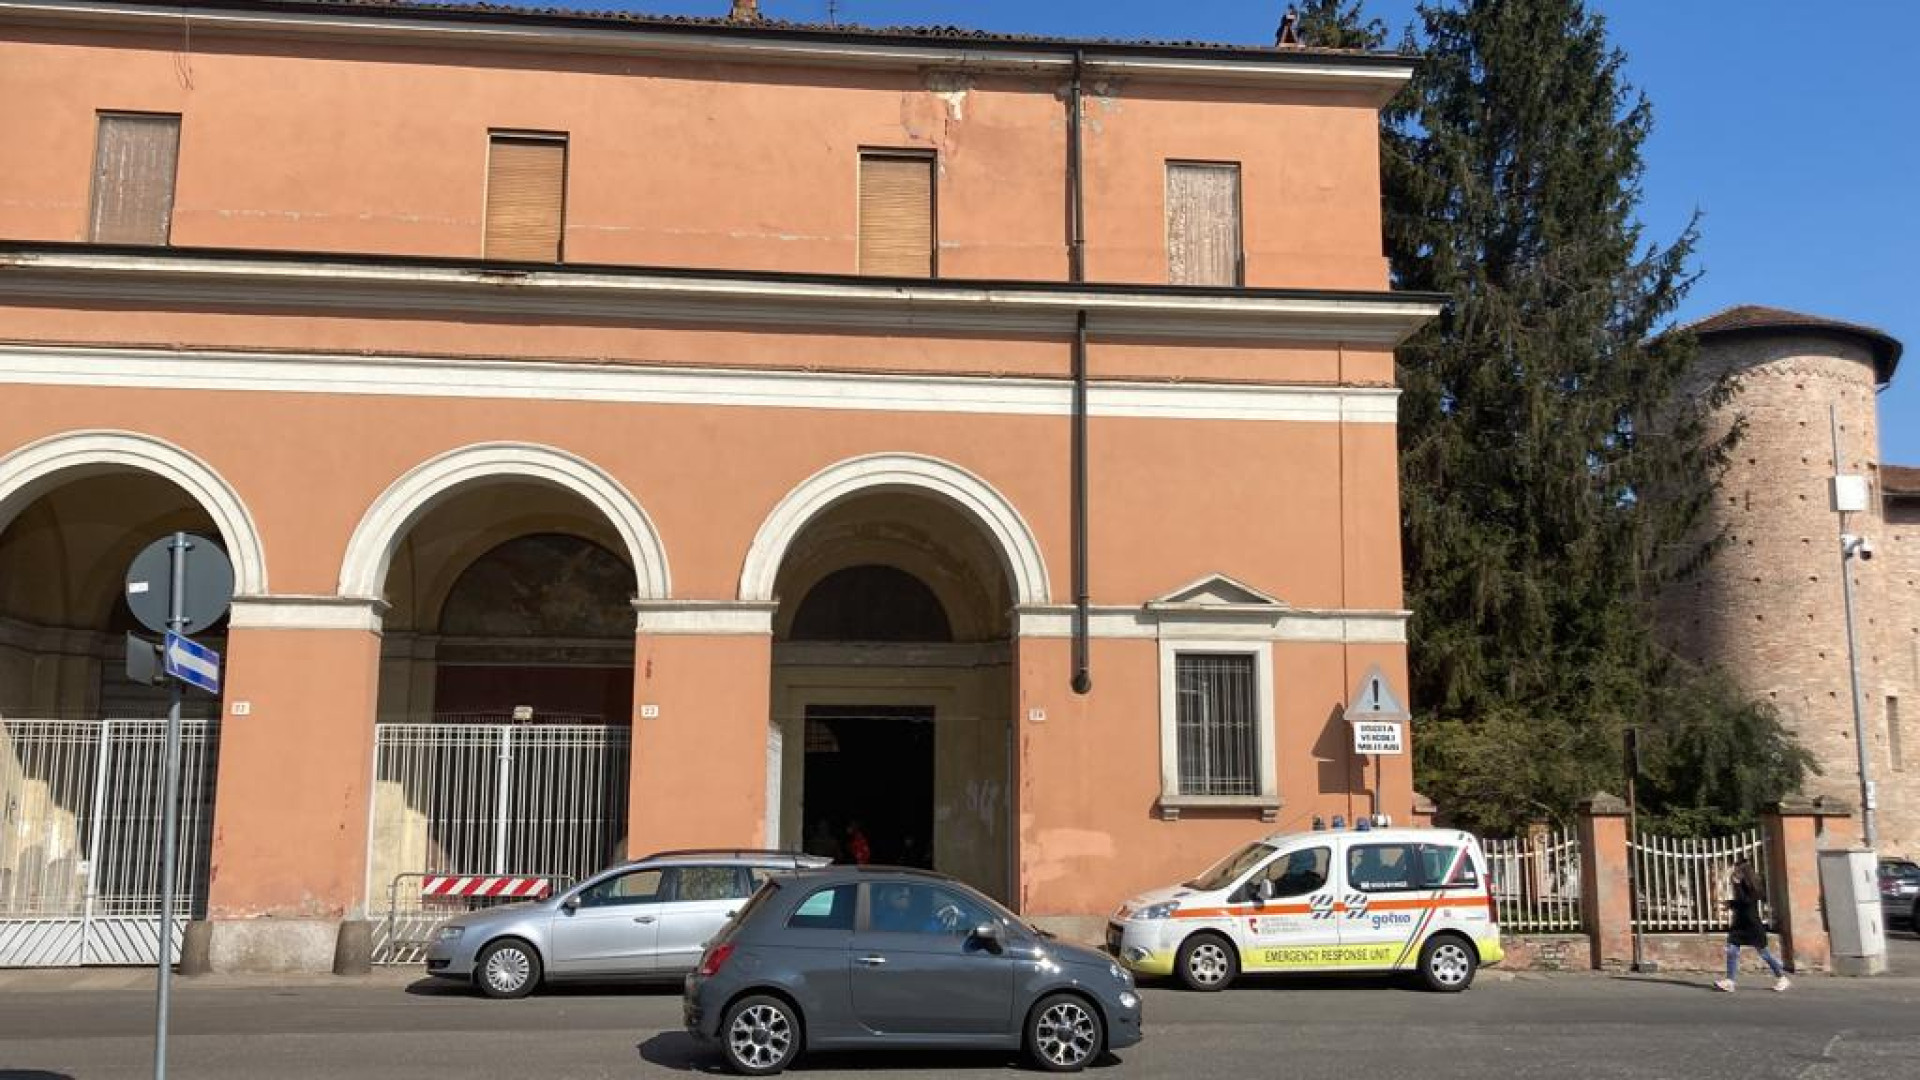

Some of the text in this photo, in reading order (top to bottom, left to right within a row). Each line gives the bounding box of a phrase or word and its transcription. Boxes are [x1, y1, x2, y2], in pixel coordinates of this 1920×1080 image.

[1265, 948, 1390, 962] EMERGENCY RESPONSE UNIT
